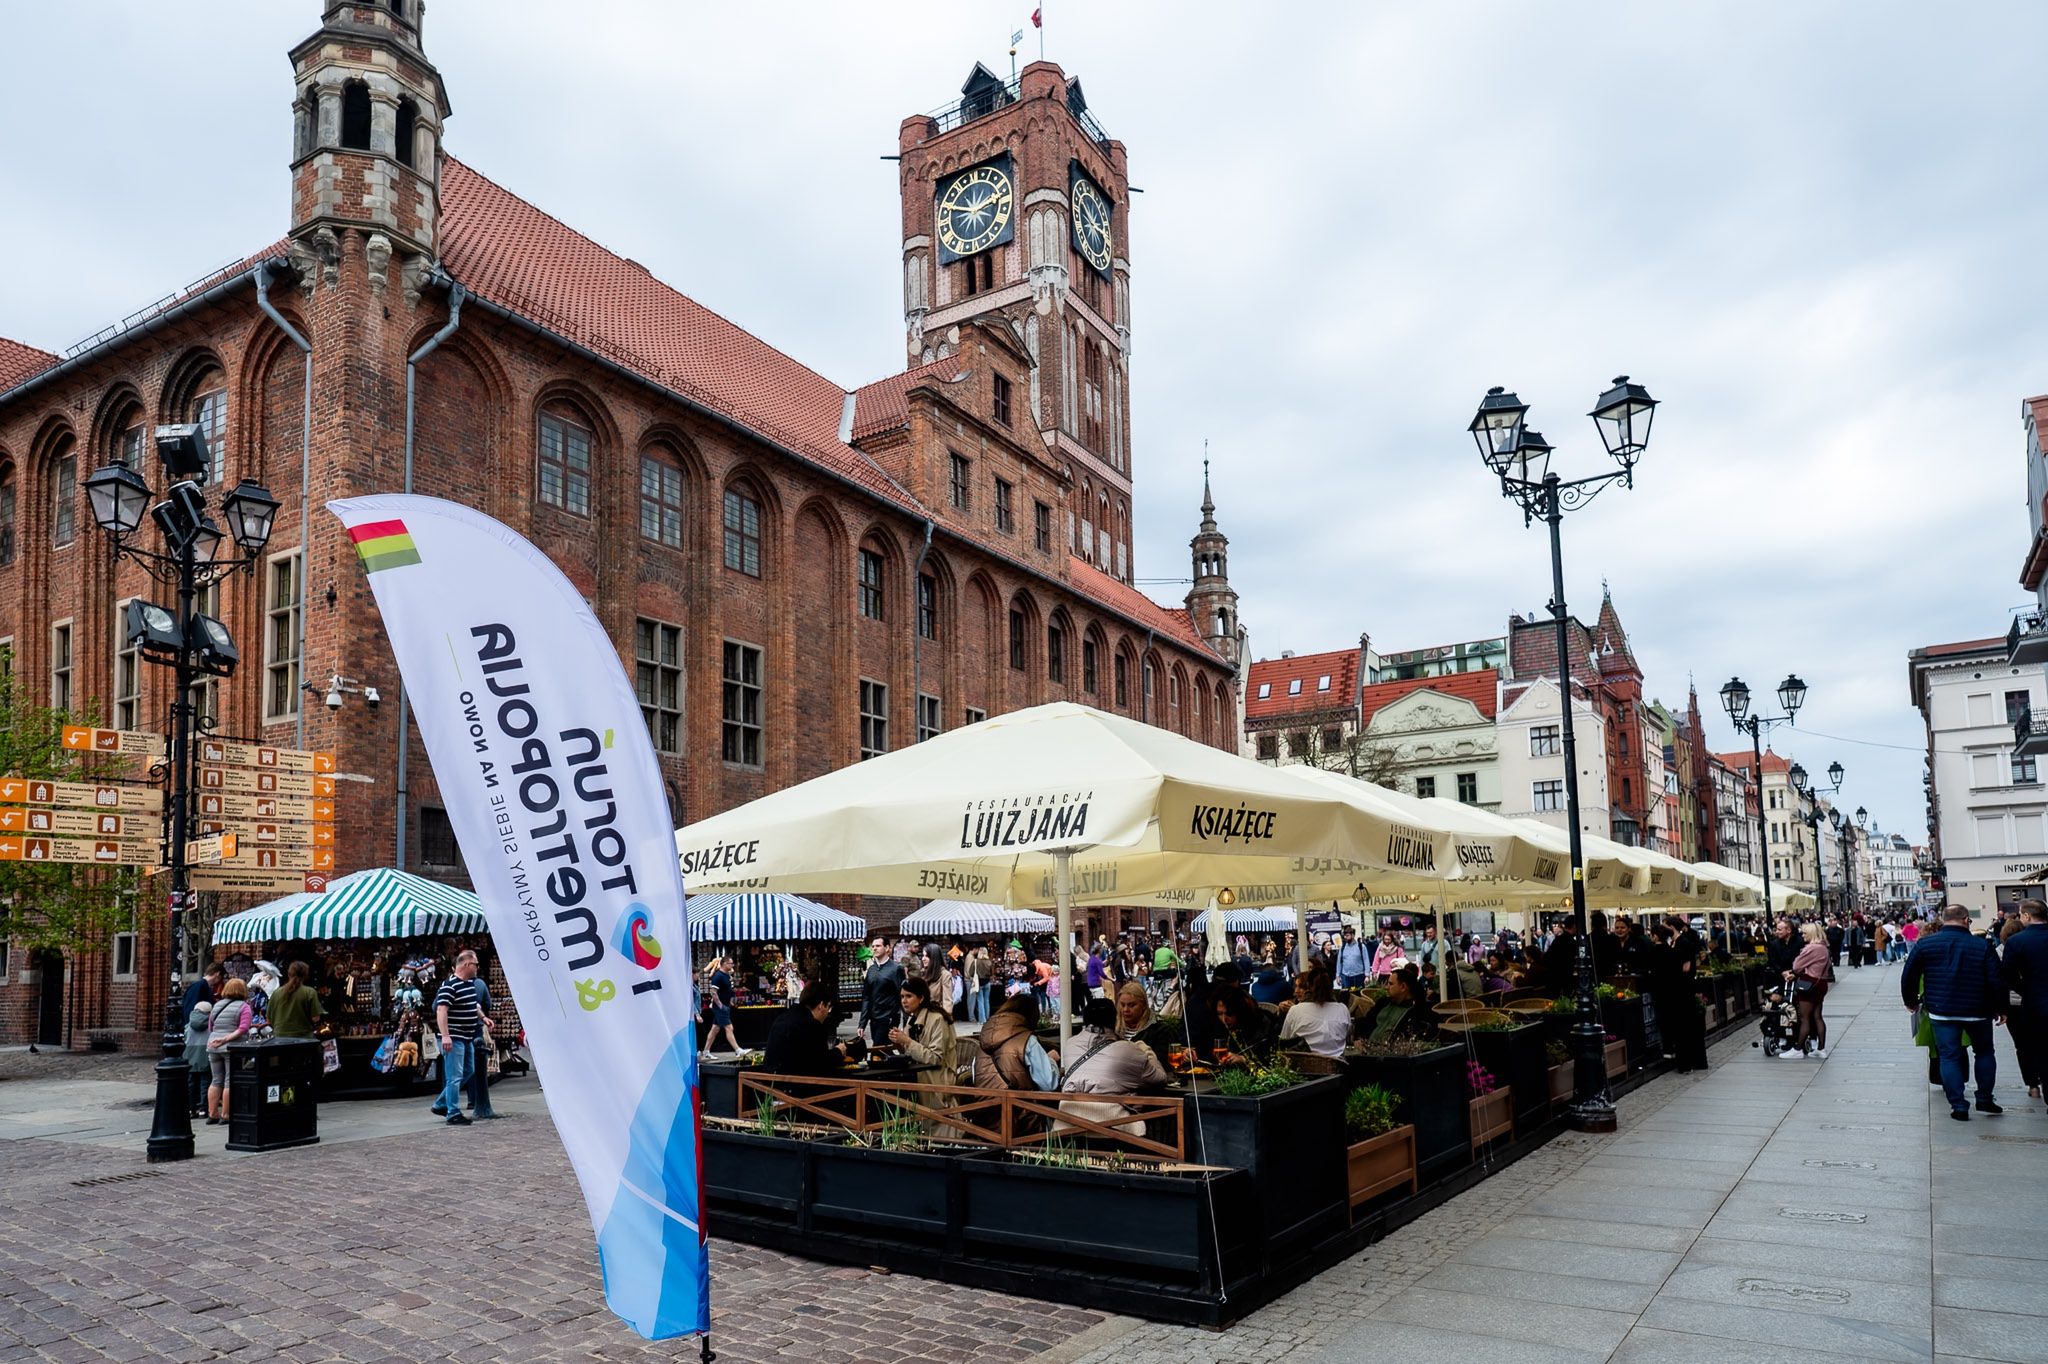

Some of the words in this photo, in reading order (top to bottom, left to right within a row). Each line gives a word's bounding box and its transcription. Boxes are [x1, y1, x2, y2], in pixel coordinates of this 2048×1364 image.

[966, 792, 1092, 810] RESTAURACJA
[961, 804, 1088, 848] LUIZJANA
[1191, 801, 1276, 844] KSIĄŻĘCE
[678, 840, 759, 878] SIĄŻĘCE
[1388, 834, 1435, 871] LUIZJANA
[1455, 841, 1494, 868] KSIĄŻĘCE
[2004, 863, 2048, 873] INFORMA
